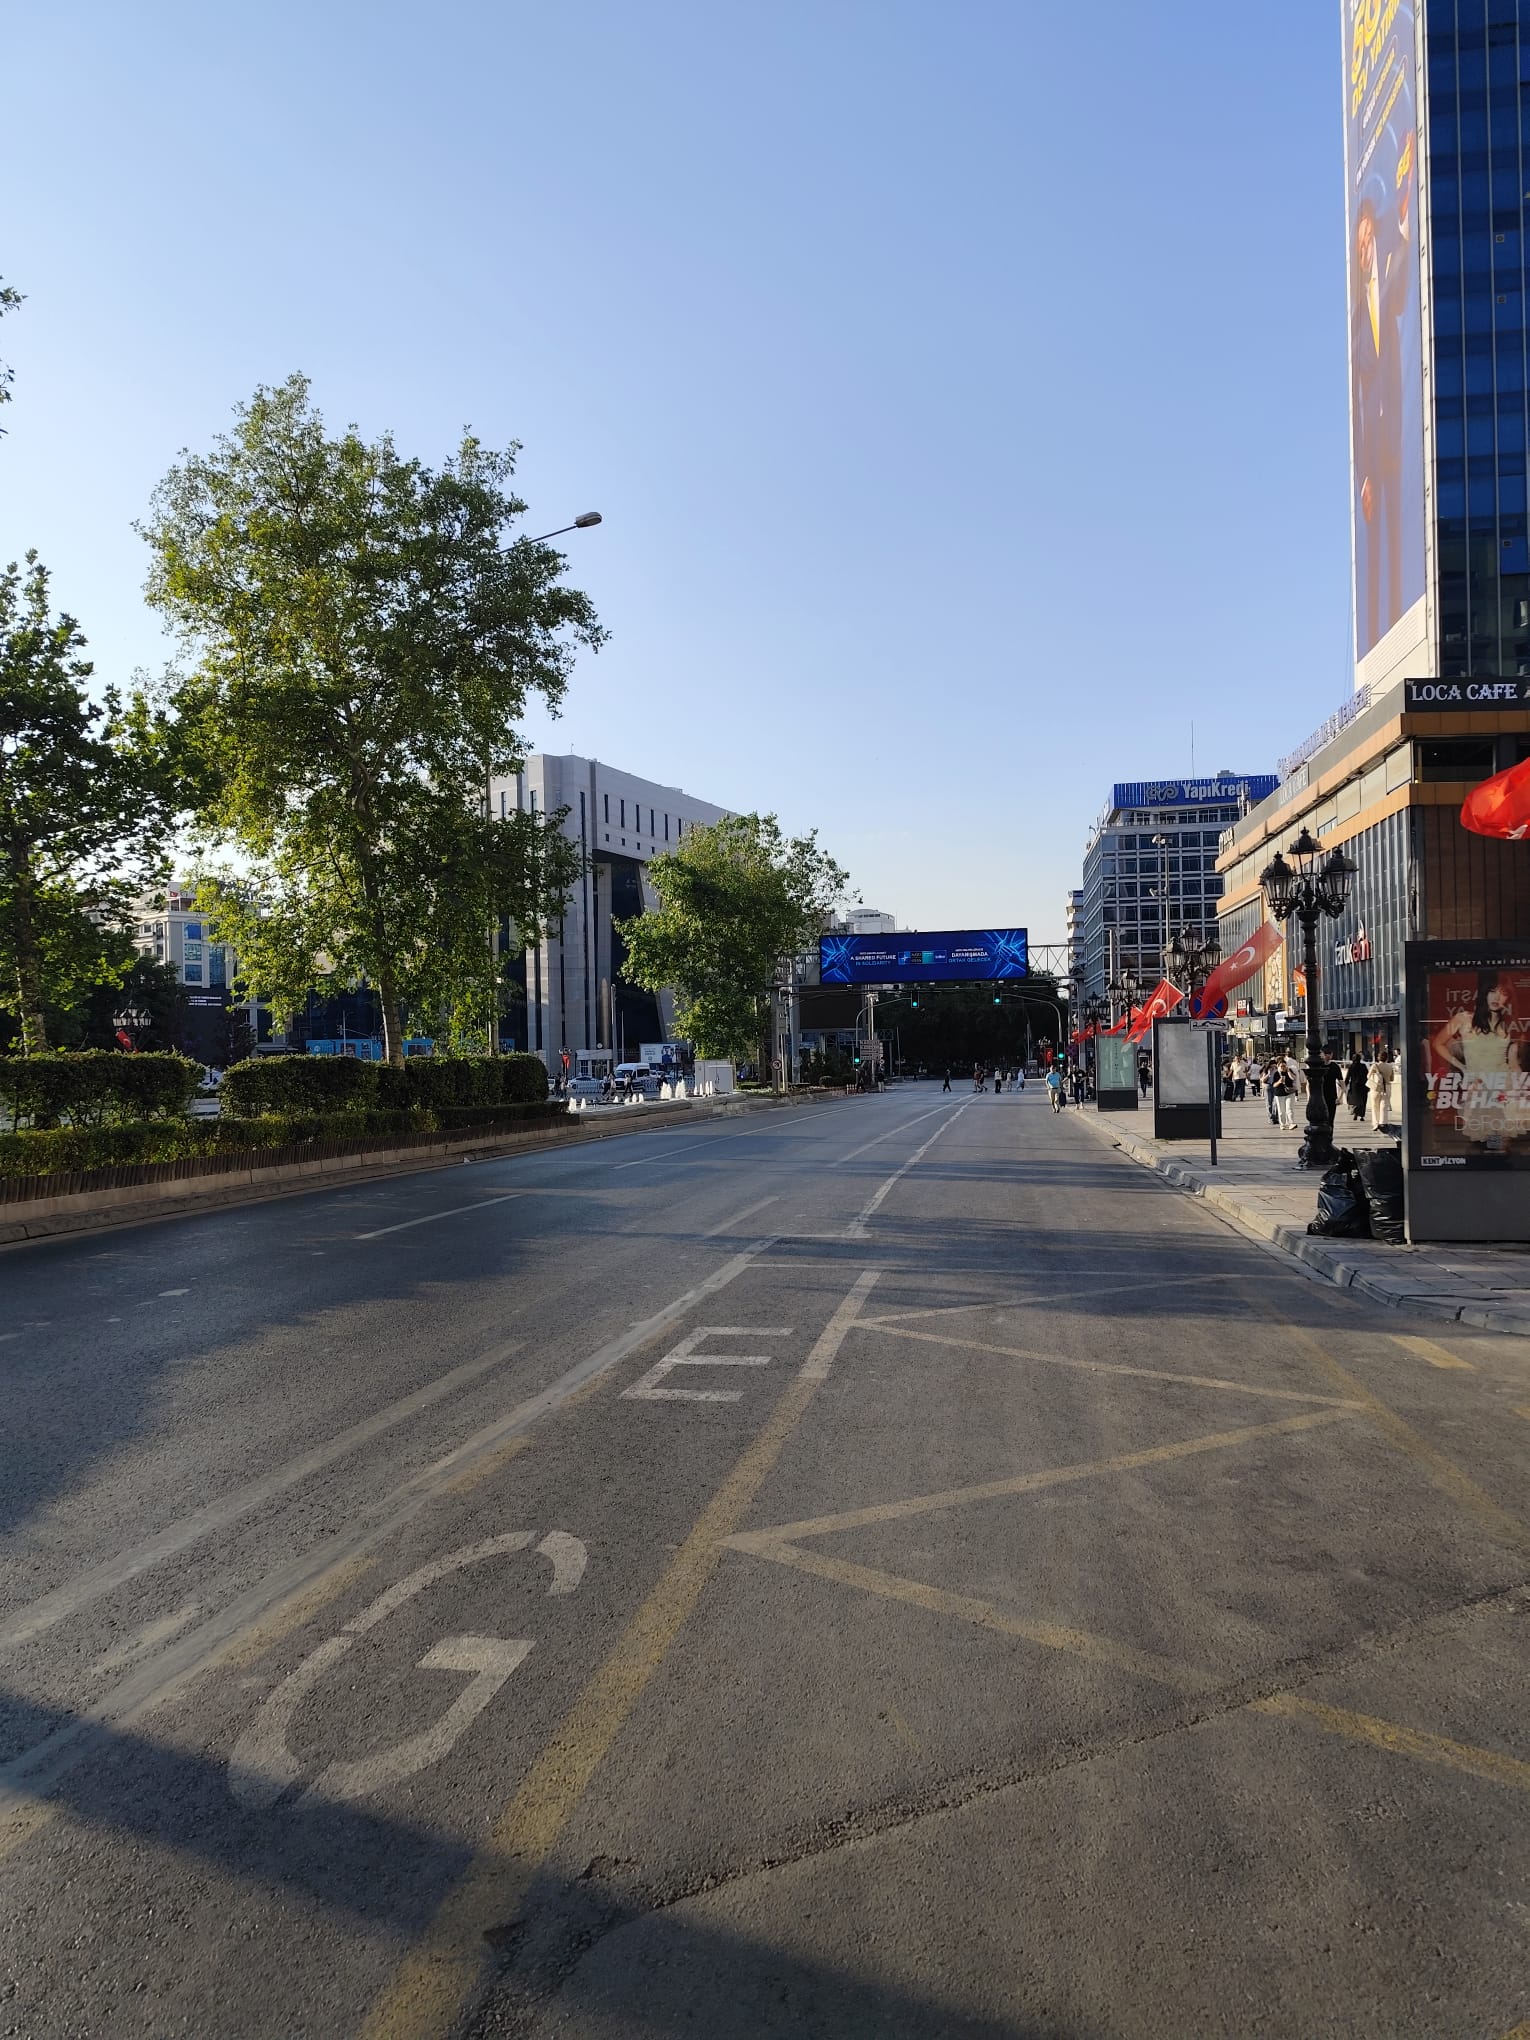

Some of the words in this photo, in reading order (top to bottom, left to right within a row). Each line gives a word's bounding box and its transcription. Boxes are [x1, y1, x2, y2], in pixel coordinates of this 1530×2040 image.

[1412, 685, 1462, 701] LOCA
[1466, 684, 1518, 700] CAFE
[1436, 1091, 1469, 1109] BU
